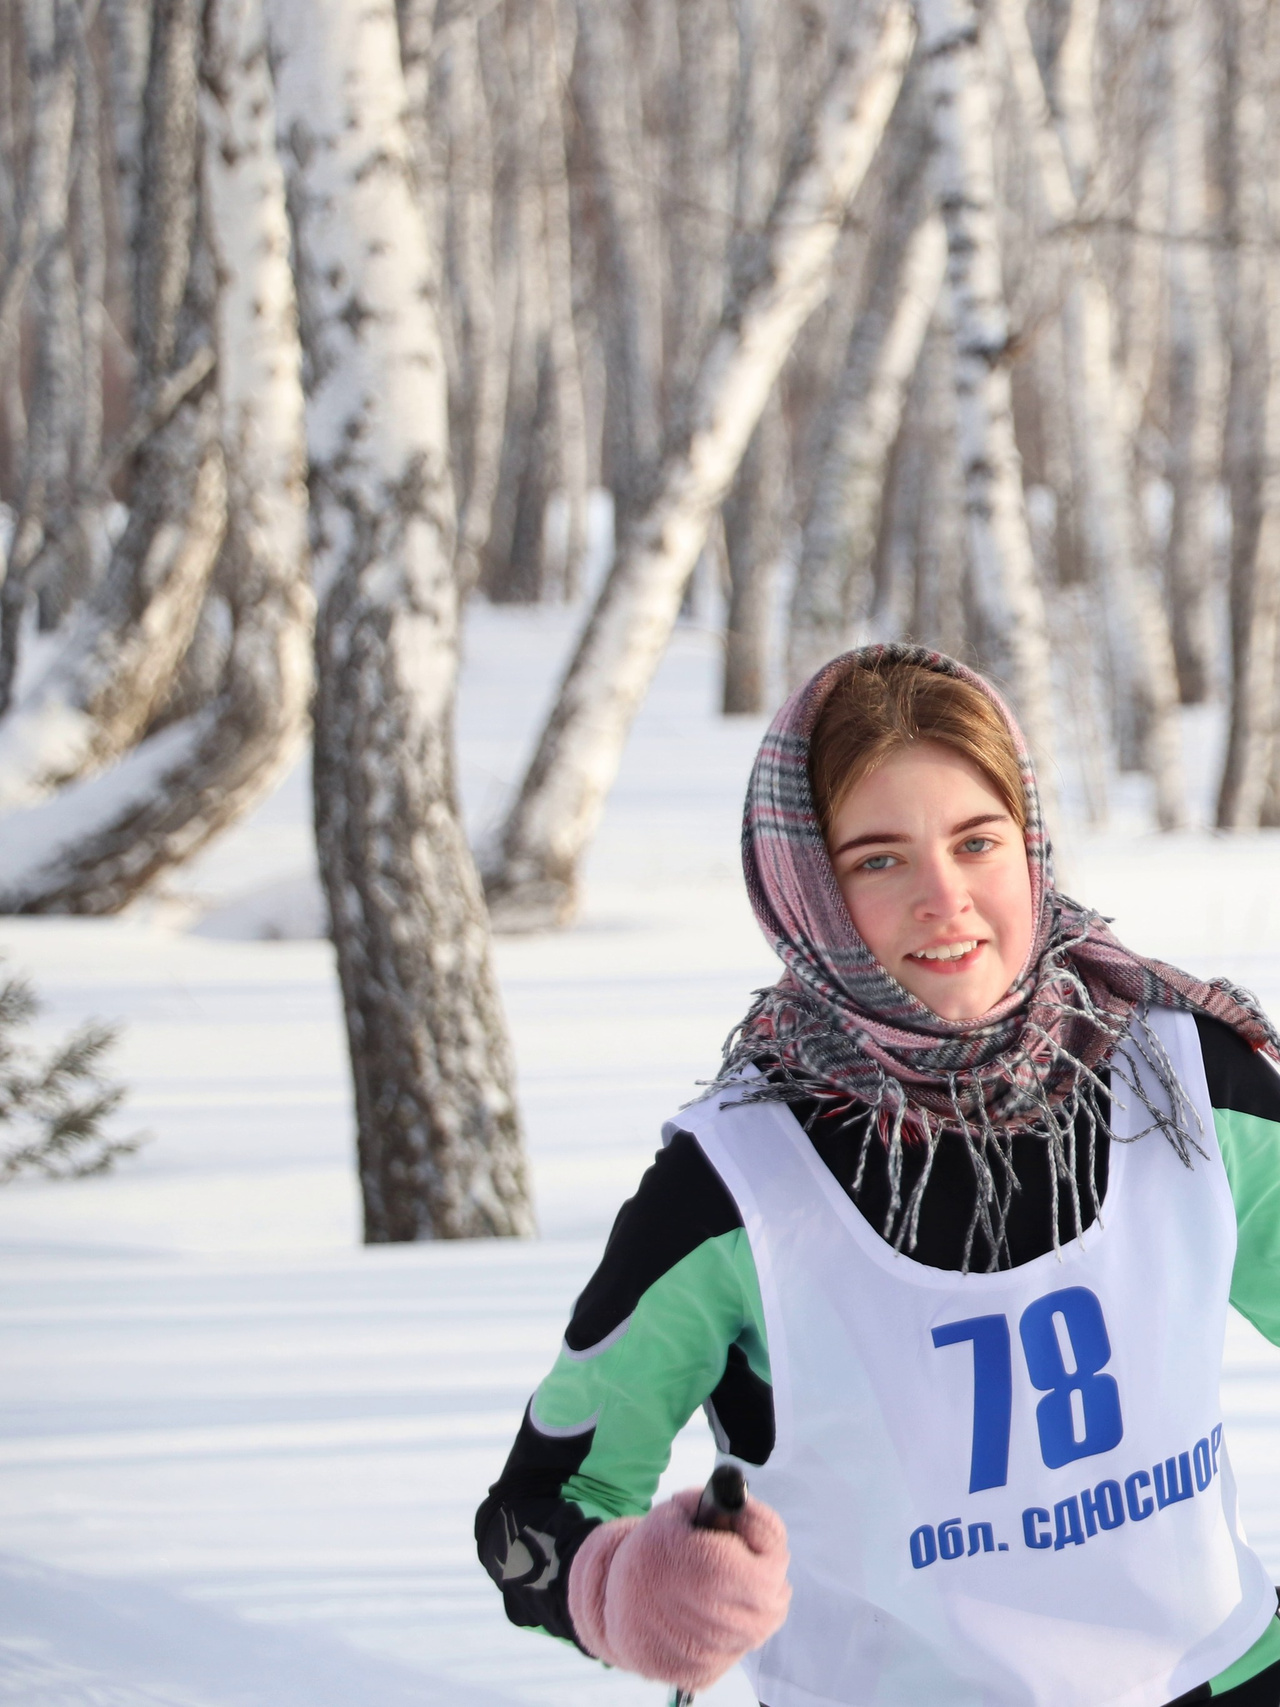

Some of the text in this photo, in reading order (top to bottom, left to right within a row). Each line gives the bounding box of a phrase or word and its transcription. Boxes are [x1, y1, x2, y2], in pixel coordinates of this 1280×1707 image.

[930, 1285, 1124, 1495] 78
[909, 1421, 1223, 1570] Обл. СДЮСШОР
